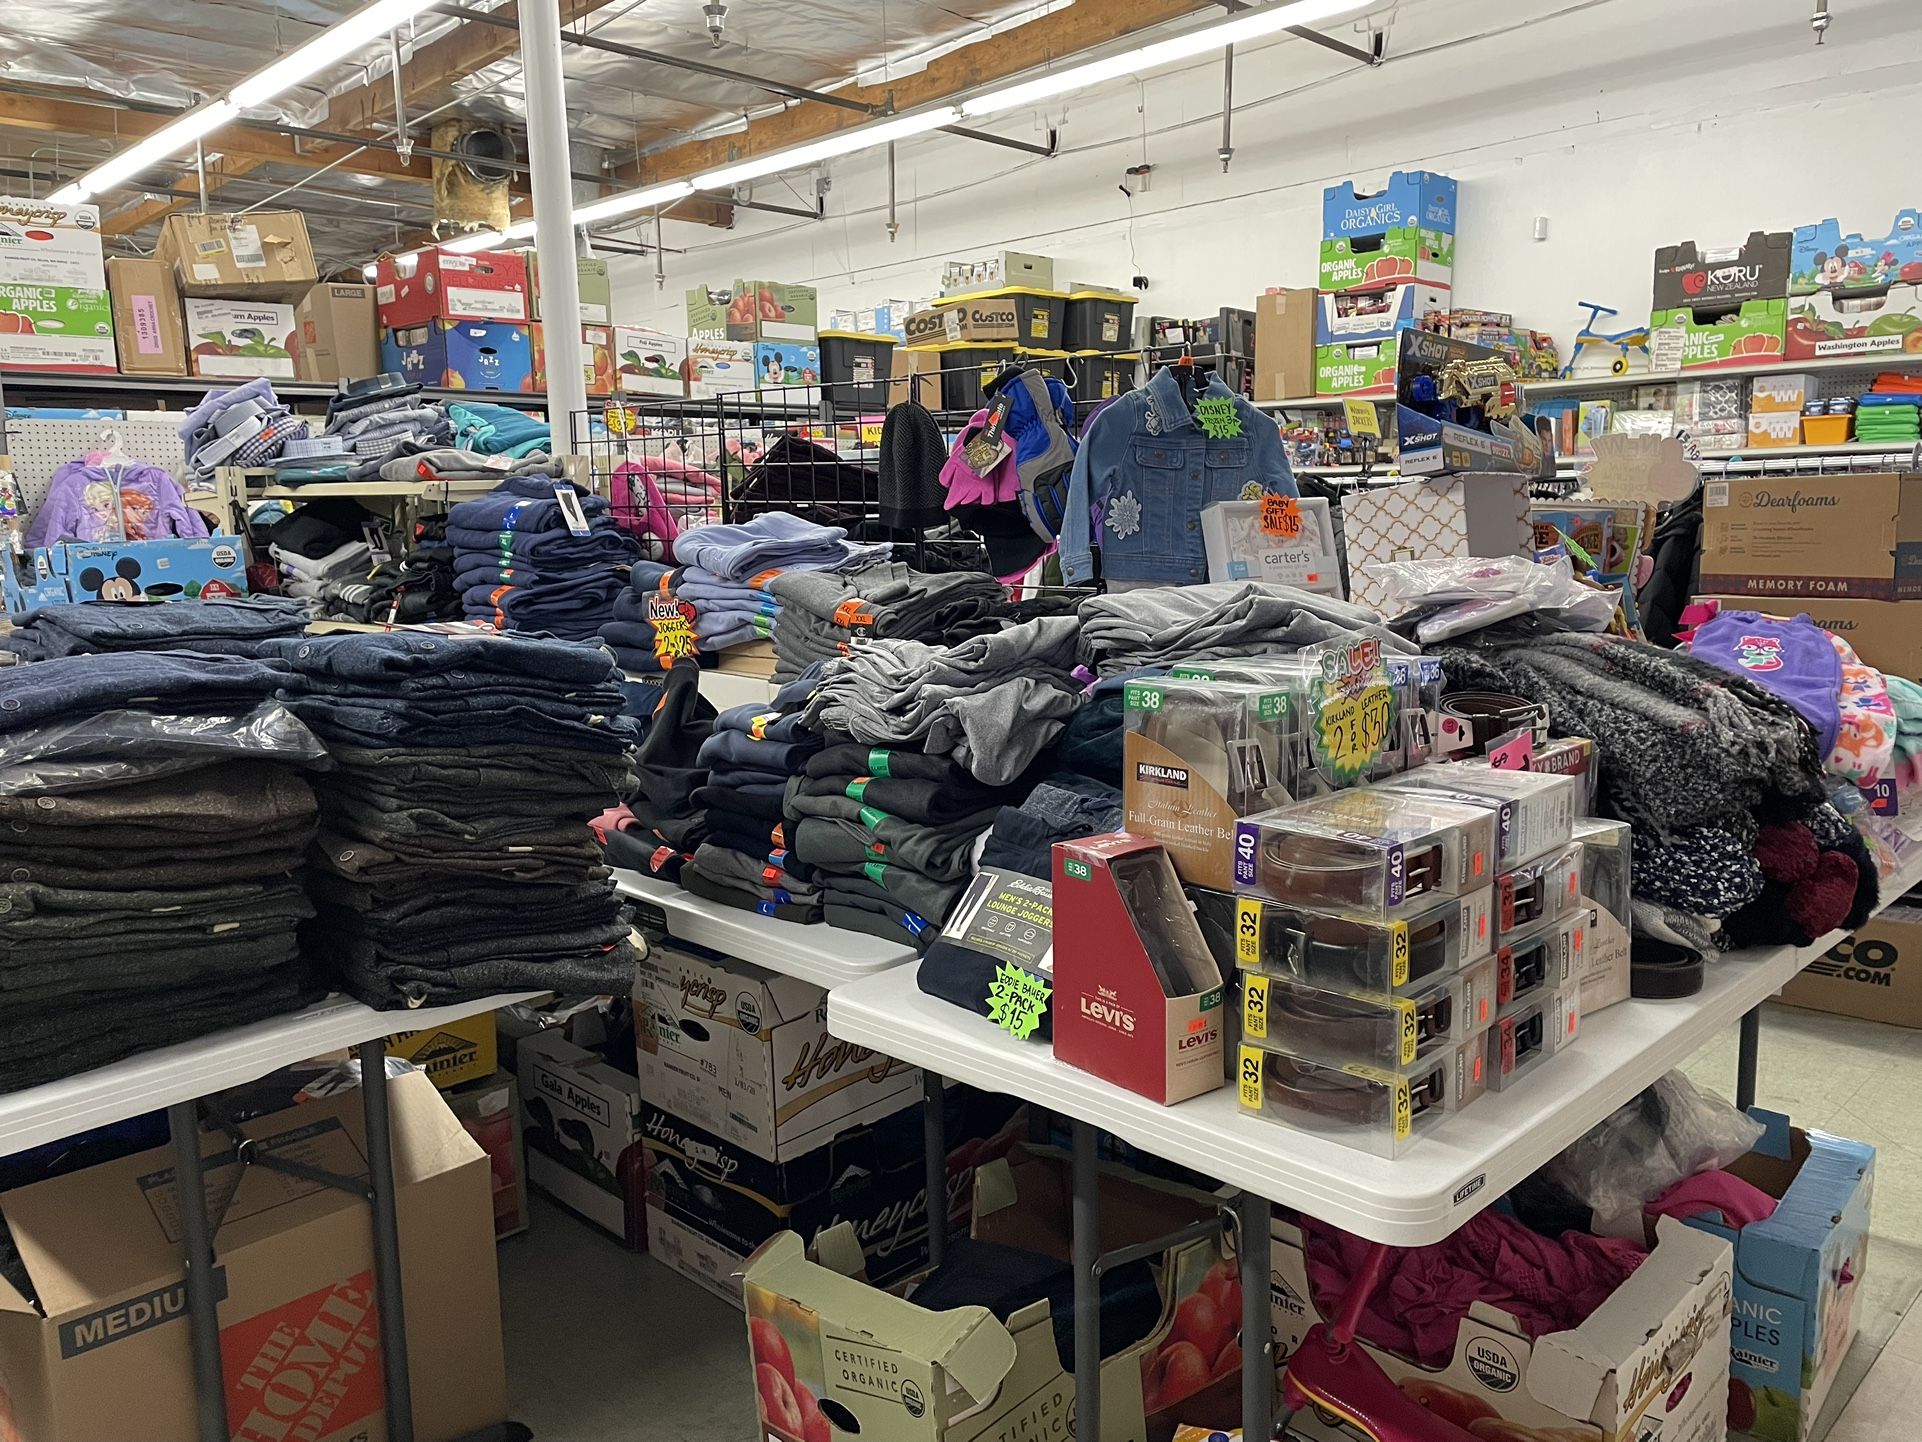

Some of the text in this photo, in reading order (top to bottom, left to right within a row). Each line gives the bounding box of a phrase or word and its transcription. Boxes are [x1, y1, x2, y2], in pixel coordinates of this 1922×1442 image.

[1341, 211, 1401, 230] ORGANICS
[1346, 203, 1398, 219] DAISY GIRL
[1321, 258, 1357, 273] ORGANIC
[1332, 268, 1362, 281] APPLES
[334, 289, 363, 297] LARGE
[1707, 281, 1758, 292] NEW ZEALAND
[12, 299, 57, 312] APPLES
[972, 310, 1014, 322] COSTCO
[247, 313, 275, 323] Apples
[905, 308, 968, 338] COSTO
[692, 327, 724, 339] APPLES
[1818, 338, 1900, 351] Washington Apples
[401, 350, 424, 371] JAZ
[478, 355, 500, 366] JAZZ
[1332, 375, 1364, 388] APPLES
[1200, 404, 1231, 416] DISNEY
[1405, 457, 1430, 465] REFLEX
[1267, 500, 1289, 508] BABY
[1754, 490, 1840, 513] Dearfoams
[1264, 550, 1310, 564] carter's
[1748, 579, 1848, 592] MEMORY FOAM
[649, 597, 679, 618] New!
[1322, 637, 1381, 682] SALE!
[1141, 691, 1159, 708] 38
[1273, 696, 1287, 714] 38
[1326, 689, 1388, 726] KIRKLAND LEATHER
[1334, 725, 1346, 760] 2
[1139, 764, 1187, 781] KIRKLAND
[1552, 751, 1580, 773] BRAND
[1875, 783, 1889, 797] 10
[1129, 811, 1175, 829] Full-Grain
[1178, 822, 1214, 837] Leather
[1502, 808, 1511, 832] 40
[1239, 834, 1255, 860] 40
[1074, 864, 1087, 876] 38
[1391, 851, 1403, 876] 40
[987, 900, 1018, 914] LOUNGE
[999, 892, 1023, 904] MEN'S
[1240, 911, 1257, 937] 32
[1396, 931, 1406, 959] 32
[995, 985, 1035, 1013] 2-PACK
[1000, 973, 1045, 1004] EDDIE BAUER
[1209, 992, 1220, 1004] 38
[1248, 987, 1264, 1013] 32
[999, 1003, 1028, 1030] $15
[1404, 1009, 1415, 1037] 32
[1243, 1058, 1259, 1084] 32
[541, 1073, 601, 1116] Gala Apples
[1398, 1085, 1408, 1114] 32
[74, 1288, 186, 1348] MEDIU
[236, 1321, 300, 1391] THE
[834, 1349, 899, 1374] CERTIFIED
[1477, 1346, 1508, 1368] USDA
[842, 1369, 899, 1392] ORGANIC
[1473, 1361, 1511, 1383] ORGANIC
[905, 1387, 920, 1400] USDA
